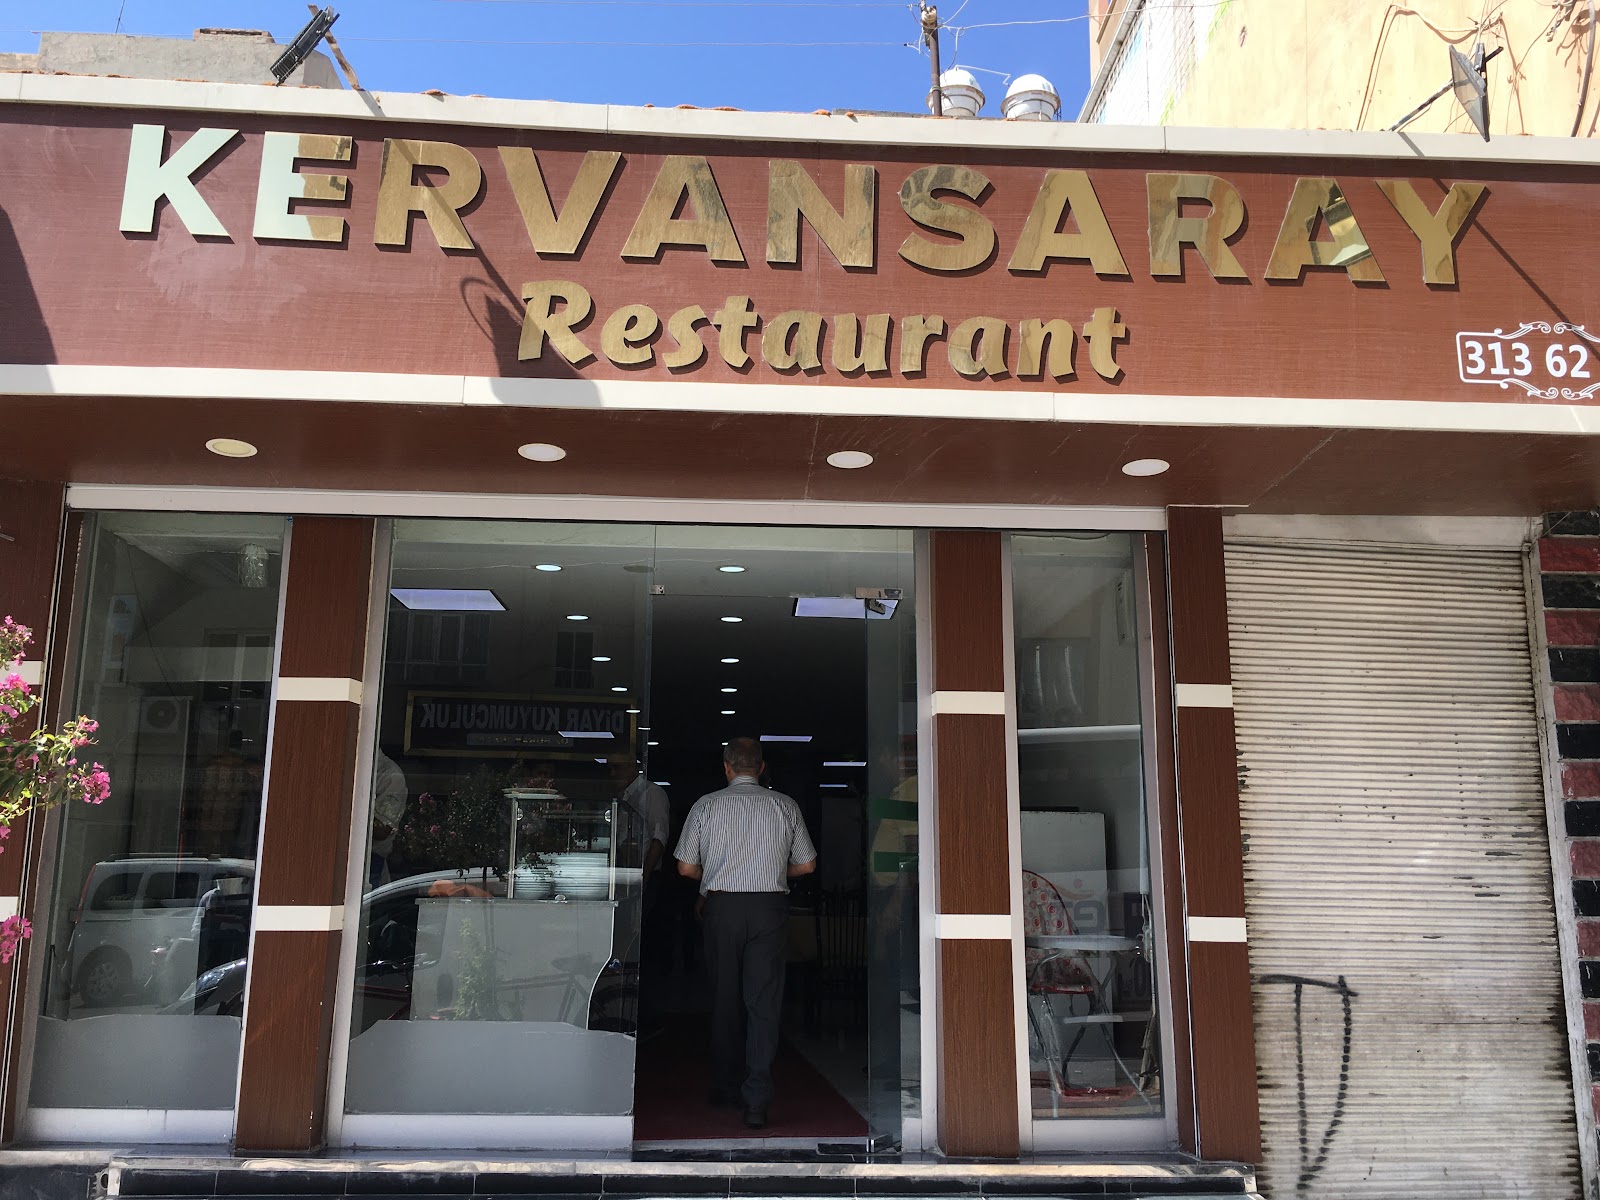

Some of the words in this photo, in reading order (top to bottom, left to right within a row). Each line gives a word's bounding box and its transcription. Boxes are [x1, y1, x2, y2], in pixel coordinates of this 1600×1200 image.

[119, 124, 1487, 285] KERVANSARAY
[517, 280, 1126, 379] Restaurant
[1464, 340, 1532, 376] 313
[1545, 343, 1590, 378] 62
